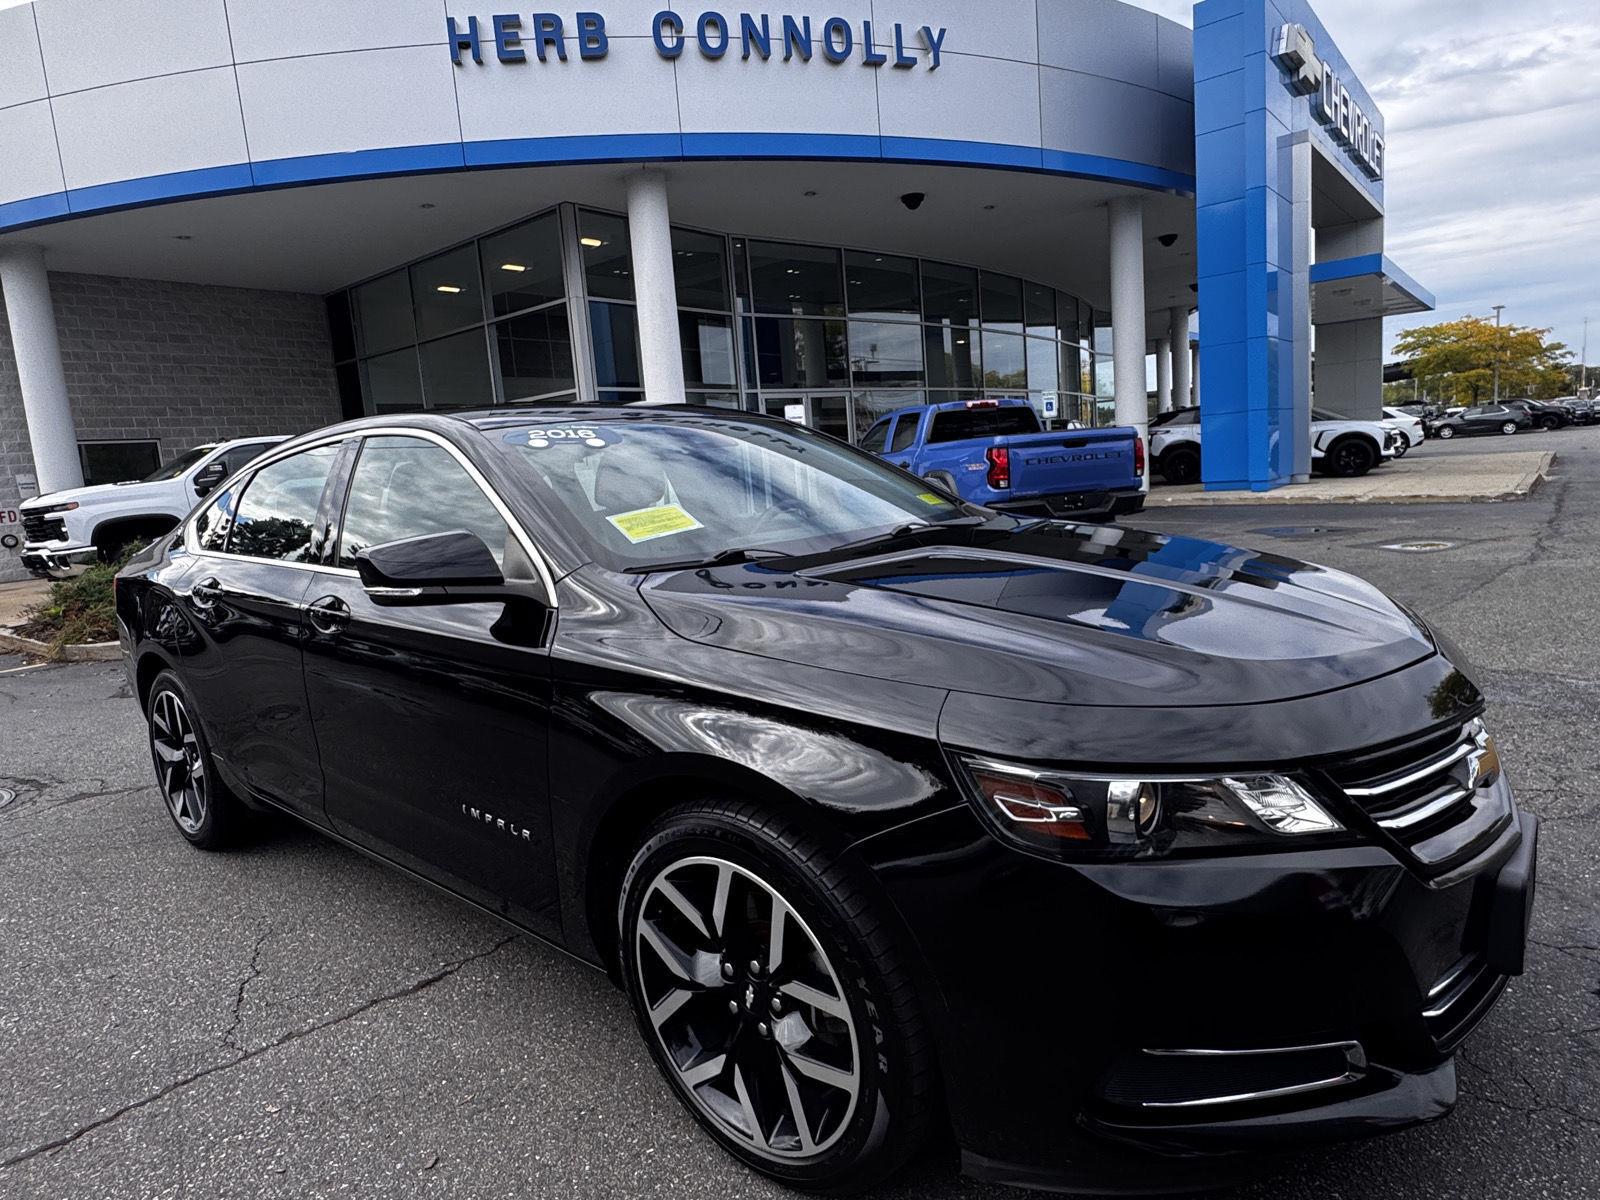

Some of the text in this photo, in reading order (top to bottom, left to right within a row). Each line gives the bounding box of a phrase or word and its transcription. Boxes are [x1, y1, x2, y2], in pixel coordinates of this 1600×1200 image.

[447, 10, 948, 72] HERB CONNOLLY
[527, 429, 597, 439] 2016
[1025, 451, 1122, 466] CHEVROLET
